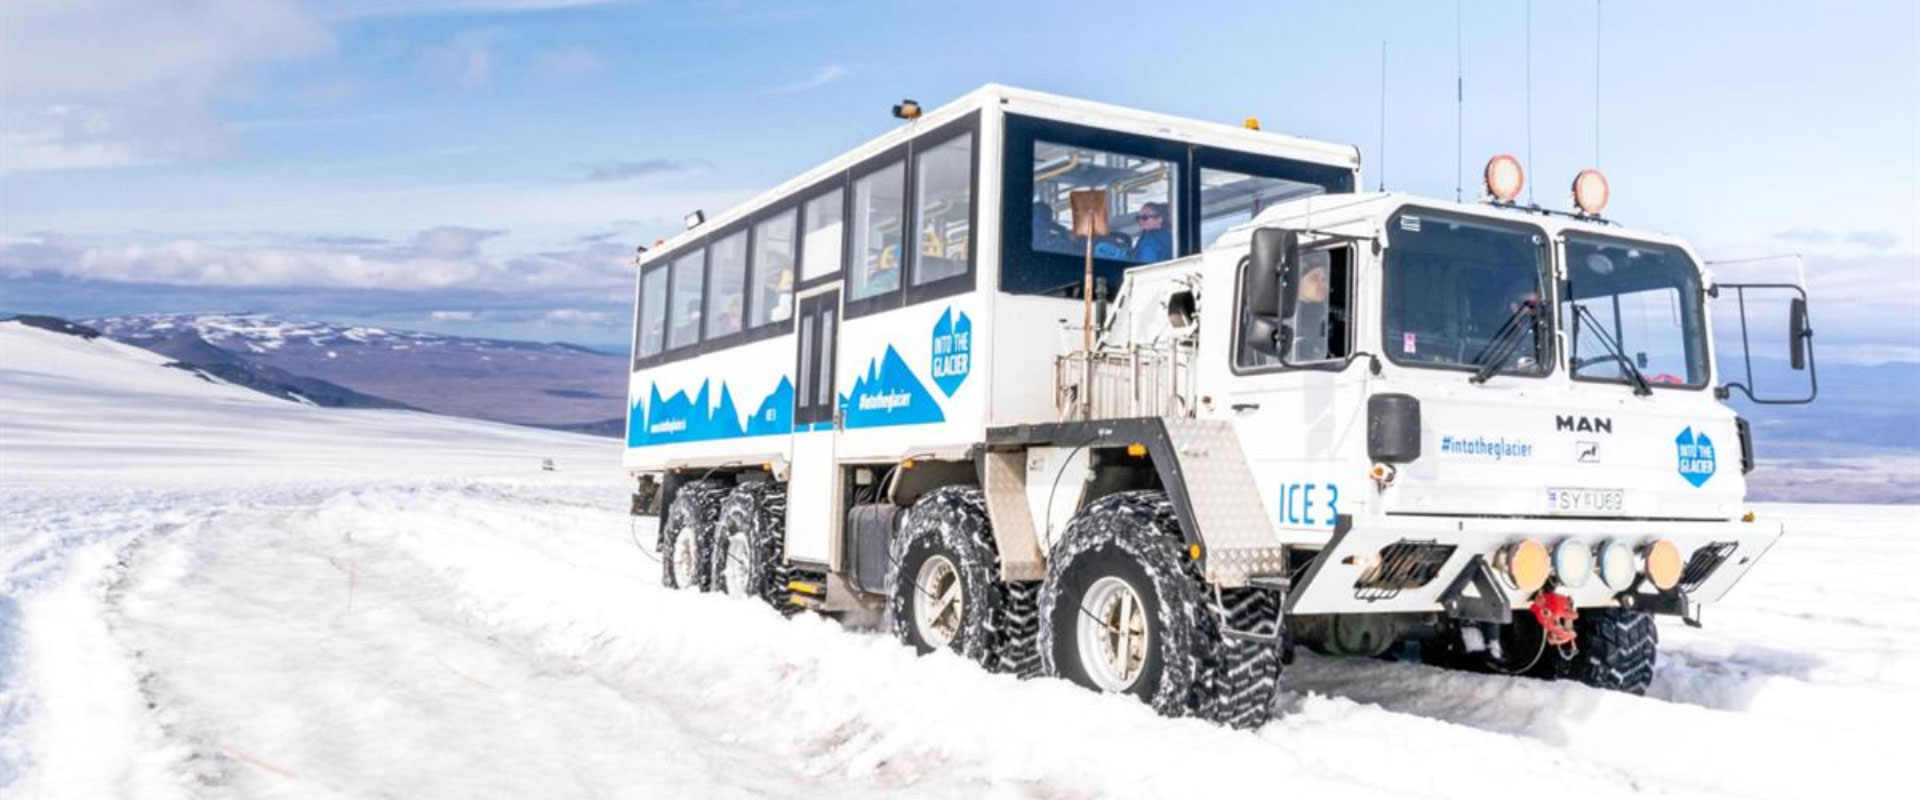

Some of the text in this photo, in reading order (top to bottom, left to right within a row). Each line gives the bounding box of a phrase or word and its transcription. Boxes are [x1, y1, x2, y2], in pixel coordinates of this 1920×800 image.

[954, 332, 969, 352] THE
[933, 353, 969, 378] GLACIER
[1556, 414, 1612, 434] MAN
[1441, 436, 1533, 460] #intotheglacier
[1679, 458, 1713, 473] GLACIER
[1279, 483, 1339, 526] ICE 3
[1560, 491, 1581, 510] SY
